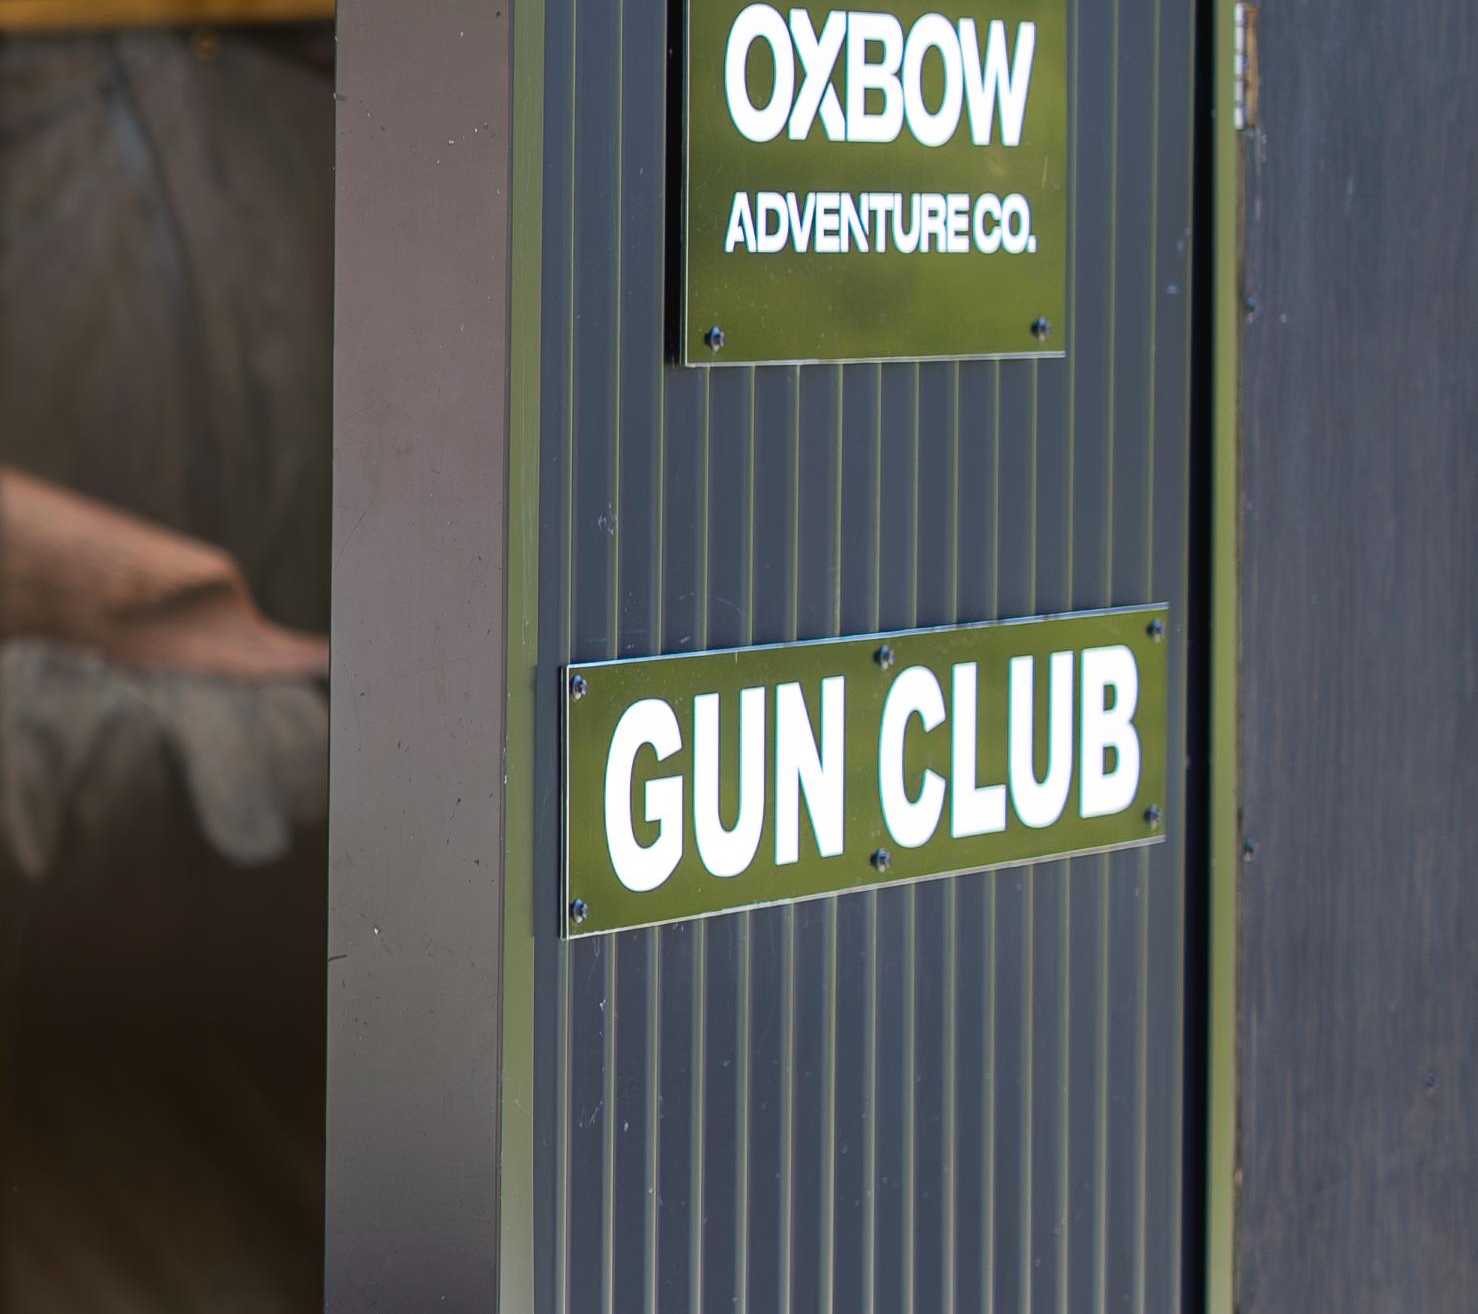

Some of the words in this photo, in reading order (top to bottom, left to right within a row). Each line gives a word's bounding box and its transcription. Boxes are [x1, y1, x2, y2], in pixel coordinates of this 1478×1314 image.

[724, 2, 1036, 147] OXBOW
[724, 191, 970, 254] ADVENTURE
[972, 192, 1038, 254] CO.
[603, 675, 847, 892] GUN
[878, 644, 1141, 849] CLUB
